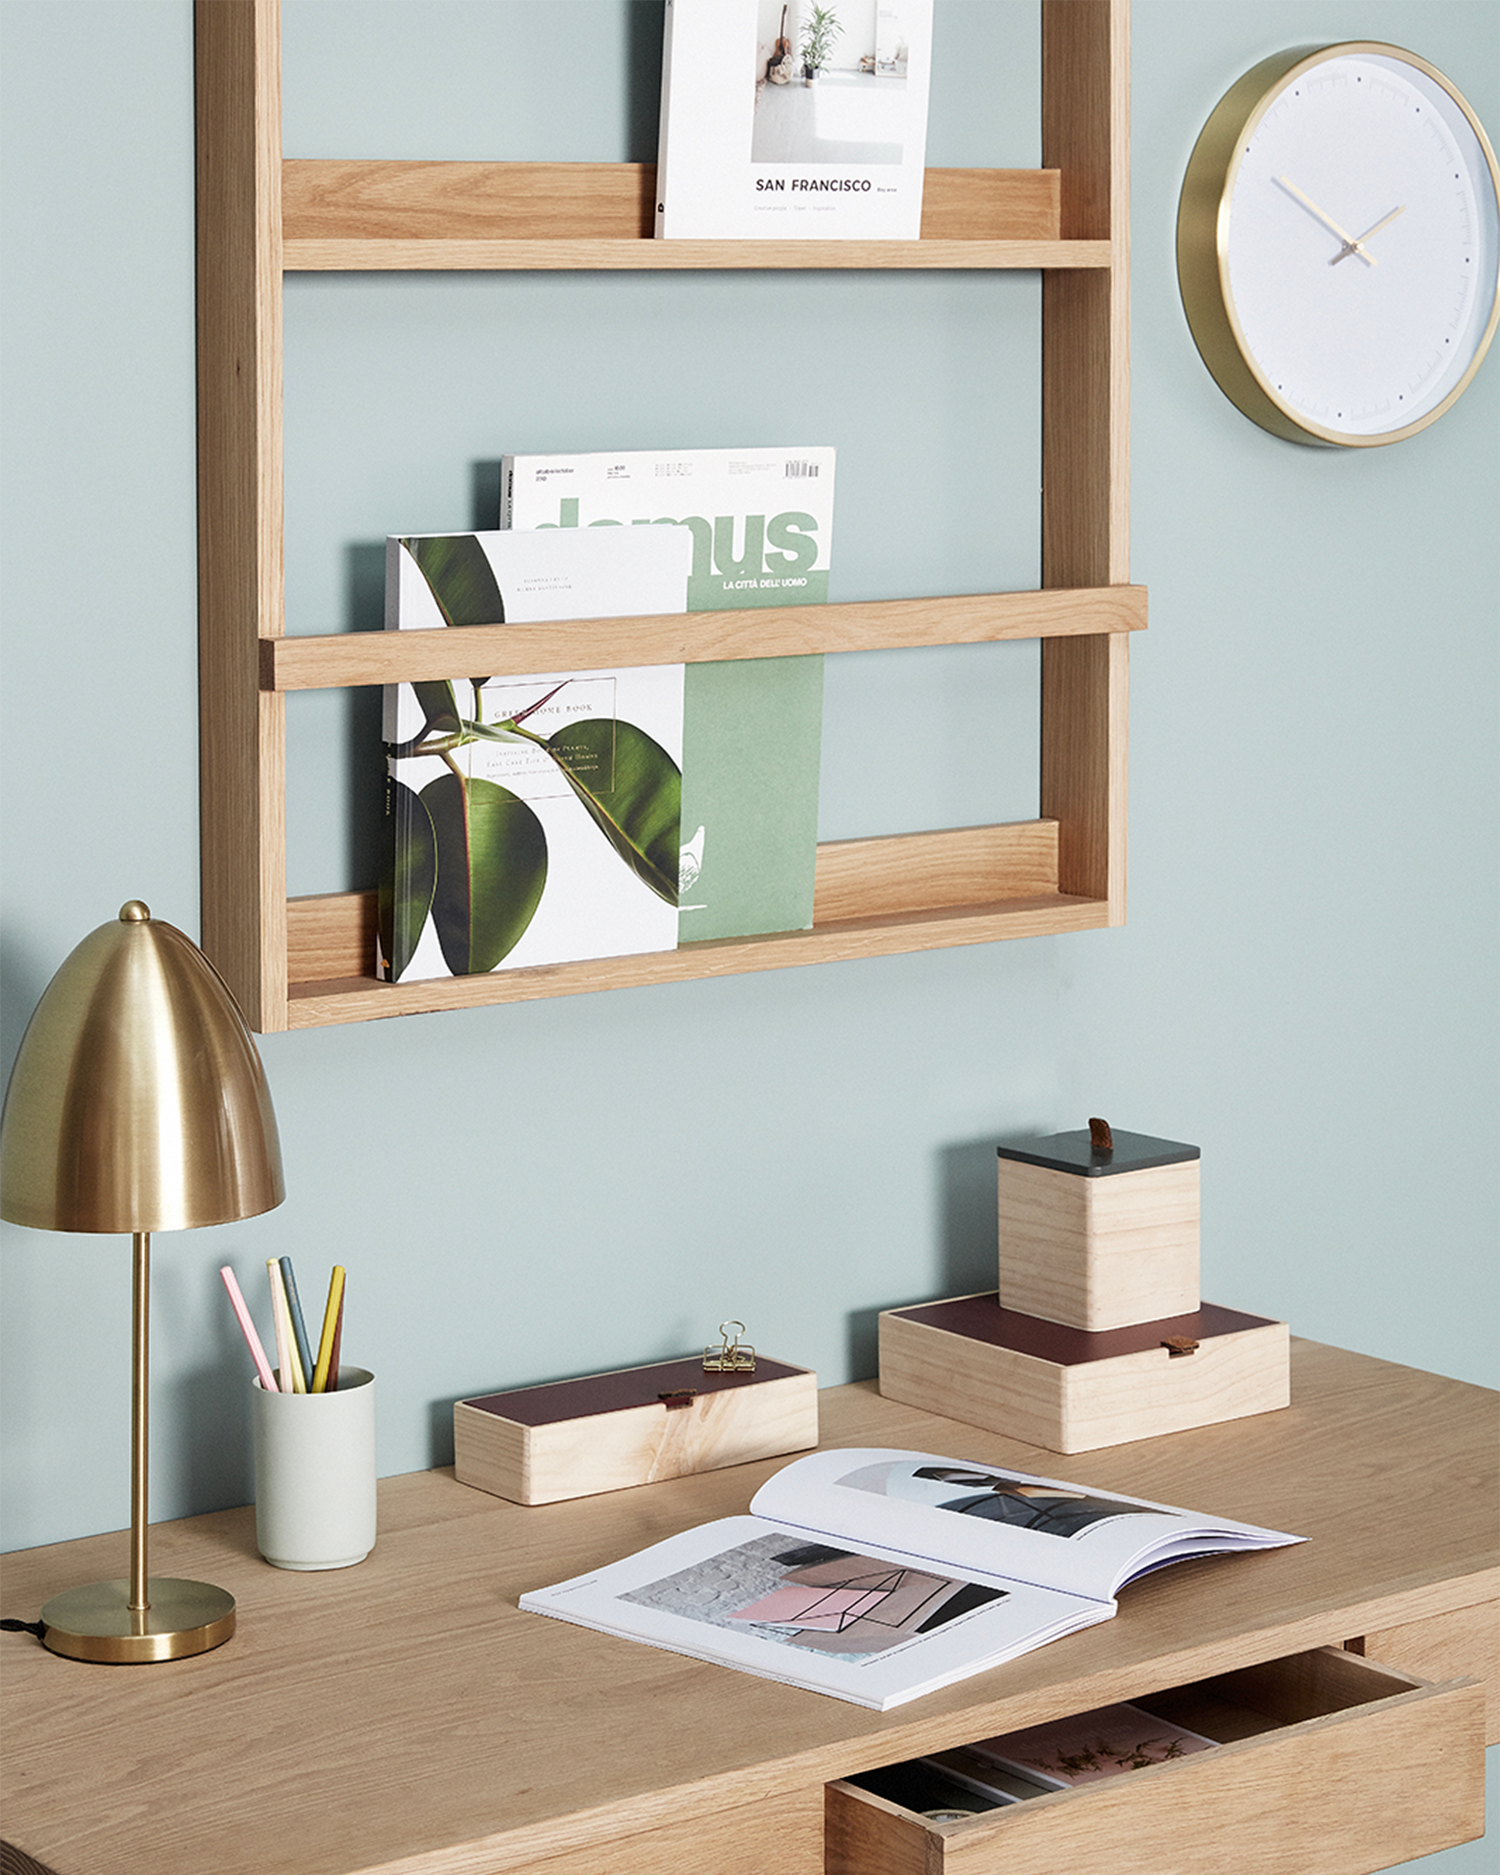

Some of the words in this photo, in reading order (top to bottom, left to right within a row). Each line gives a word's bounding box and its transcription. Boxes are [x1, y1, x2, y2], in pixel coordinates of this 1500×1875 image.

[755, 178, 785, 192] SAN
[791, 178, 872, 192] FRANCISCO
[534, 497, 819, 575] mus
[723, 581, 735, 590] LA
[735, 578, 758, 590] CITTÀ
[781, 577, 808, 588] UOMO
[566, 703, 593, 713] BOOK
